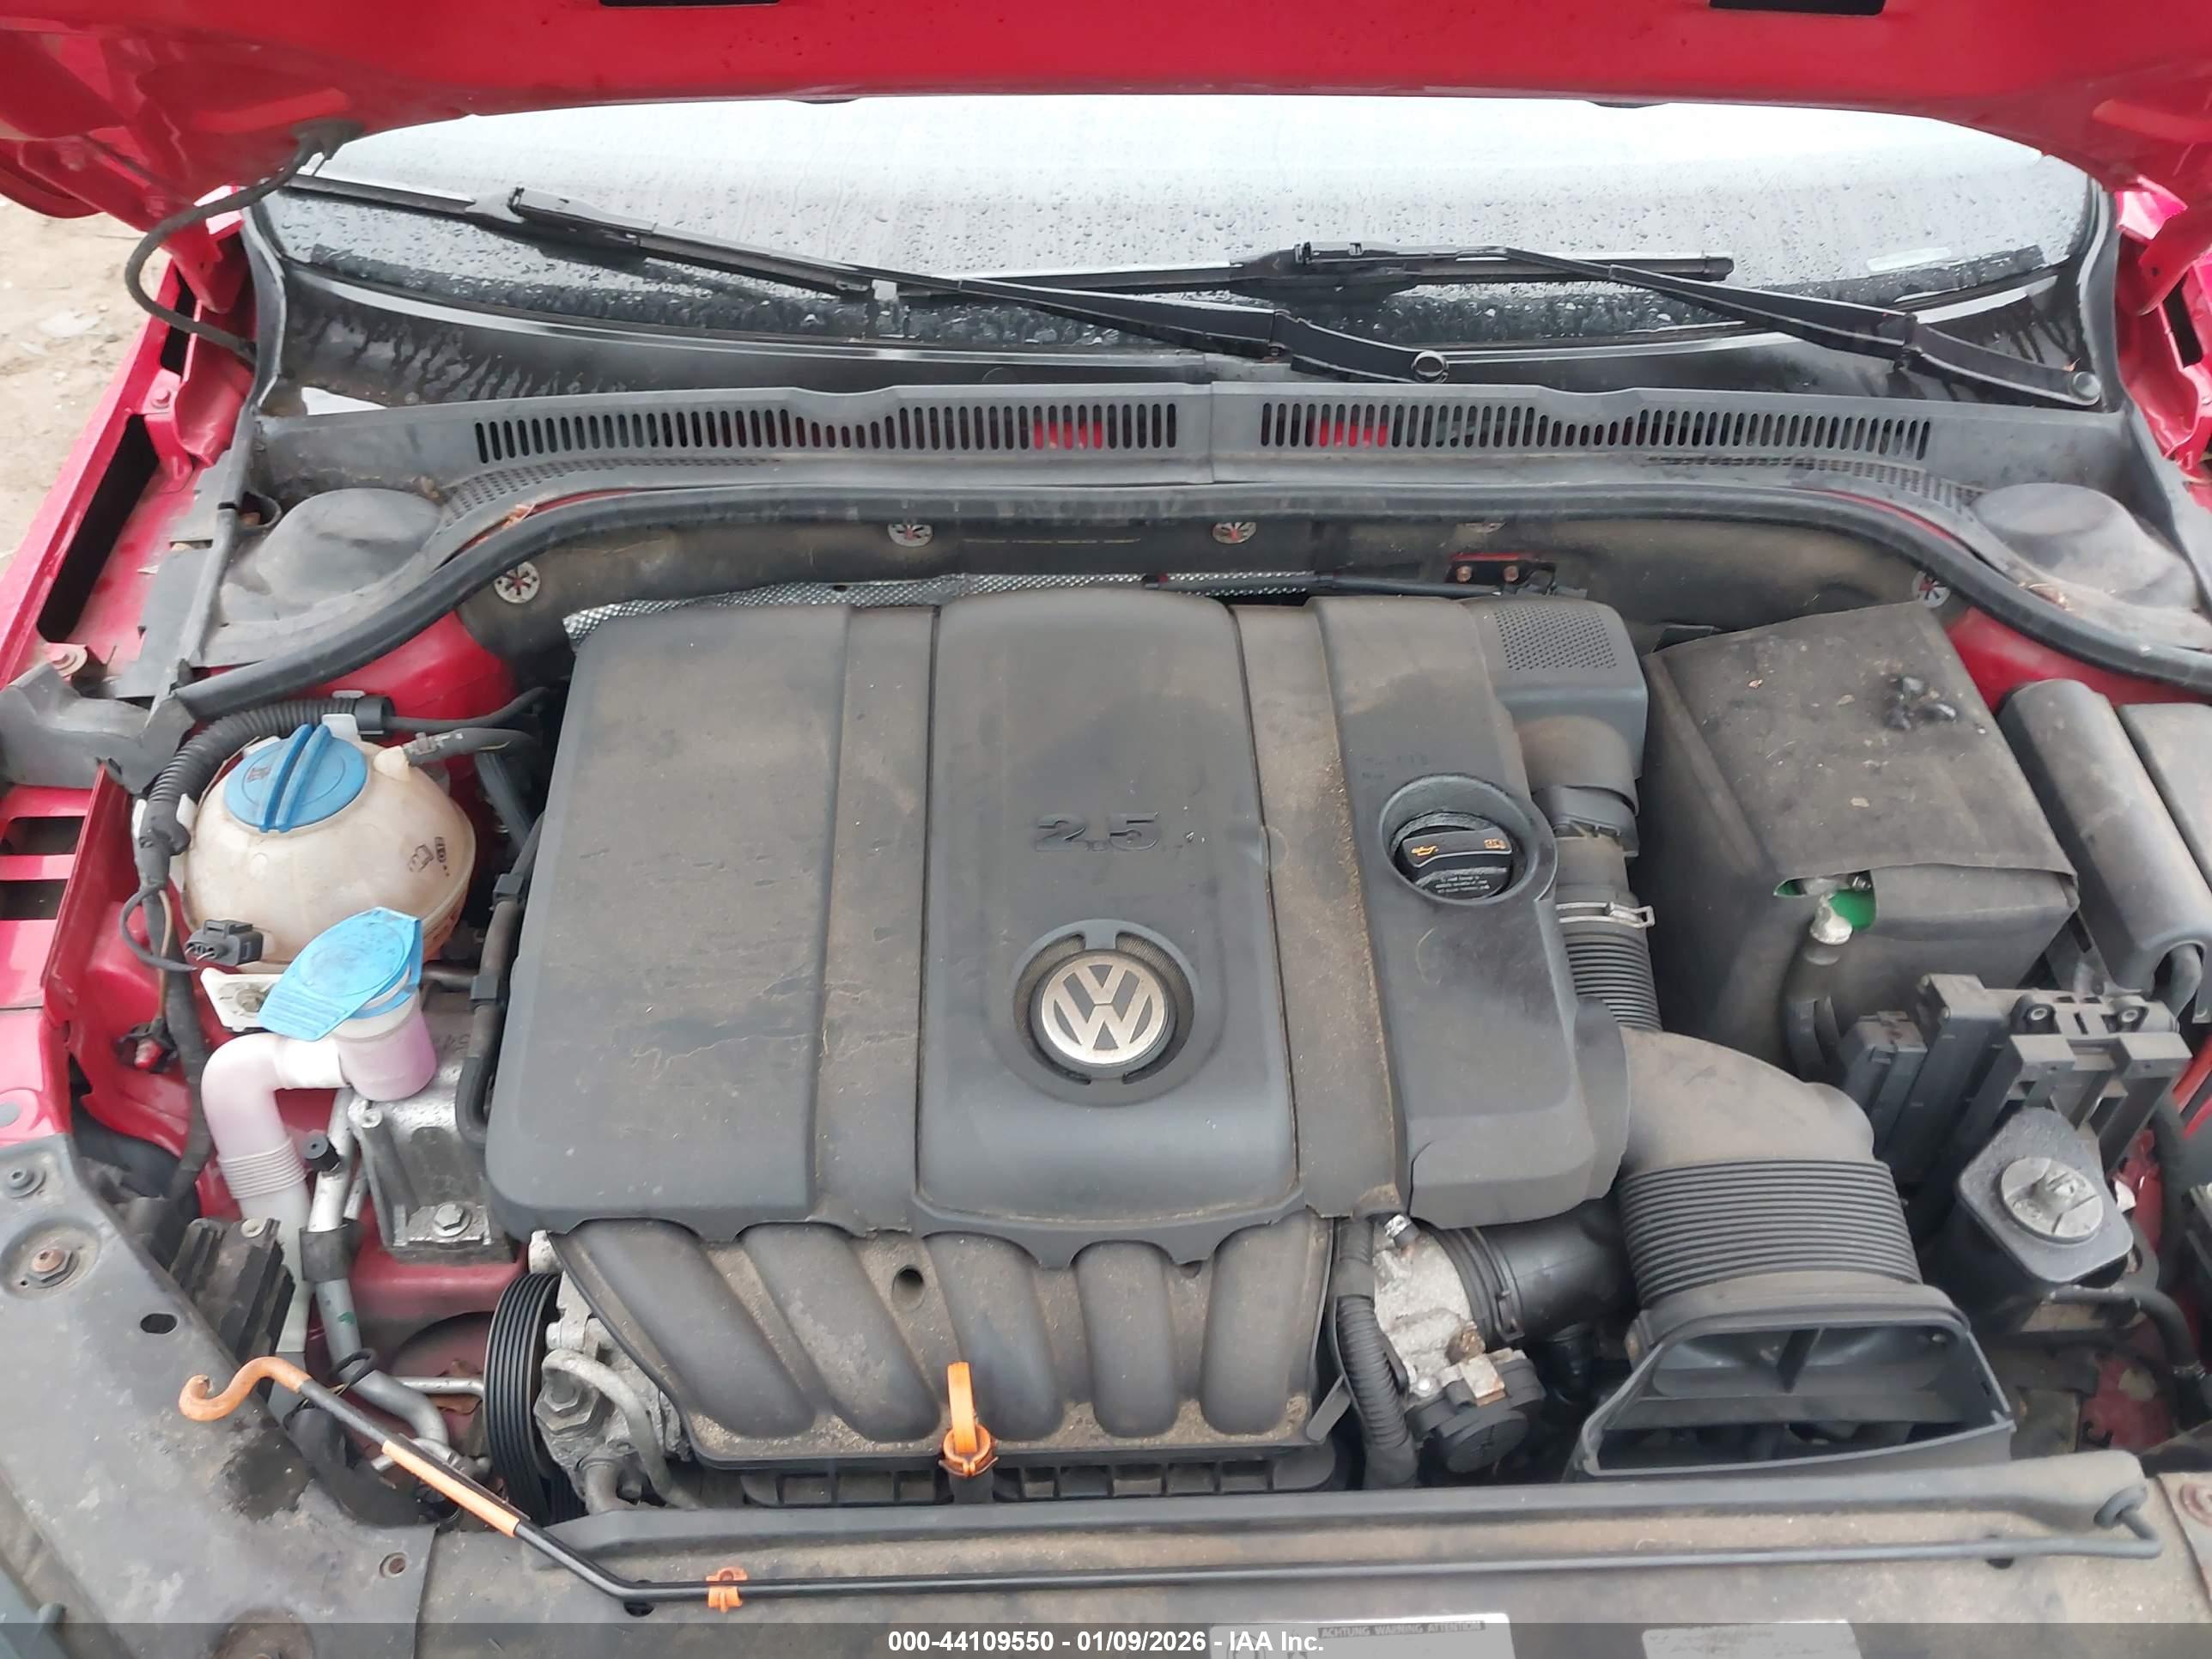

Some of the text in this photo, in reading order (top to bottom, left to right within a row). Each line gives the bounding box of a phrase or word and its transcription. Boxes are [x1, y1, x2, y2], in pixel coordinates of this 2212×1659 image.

[1036, 811, 1160, 852] 2.5
[1045, 957, 1162, 1060] VW
[1321, 1620, 1480, 1638] ACHTUNG WARNING ATTENTION
